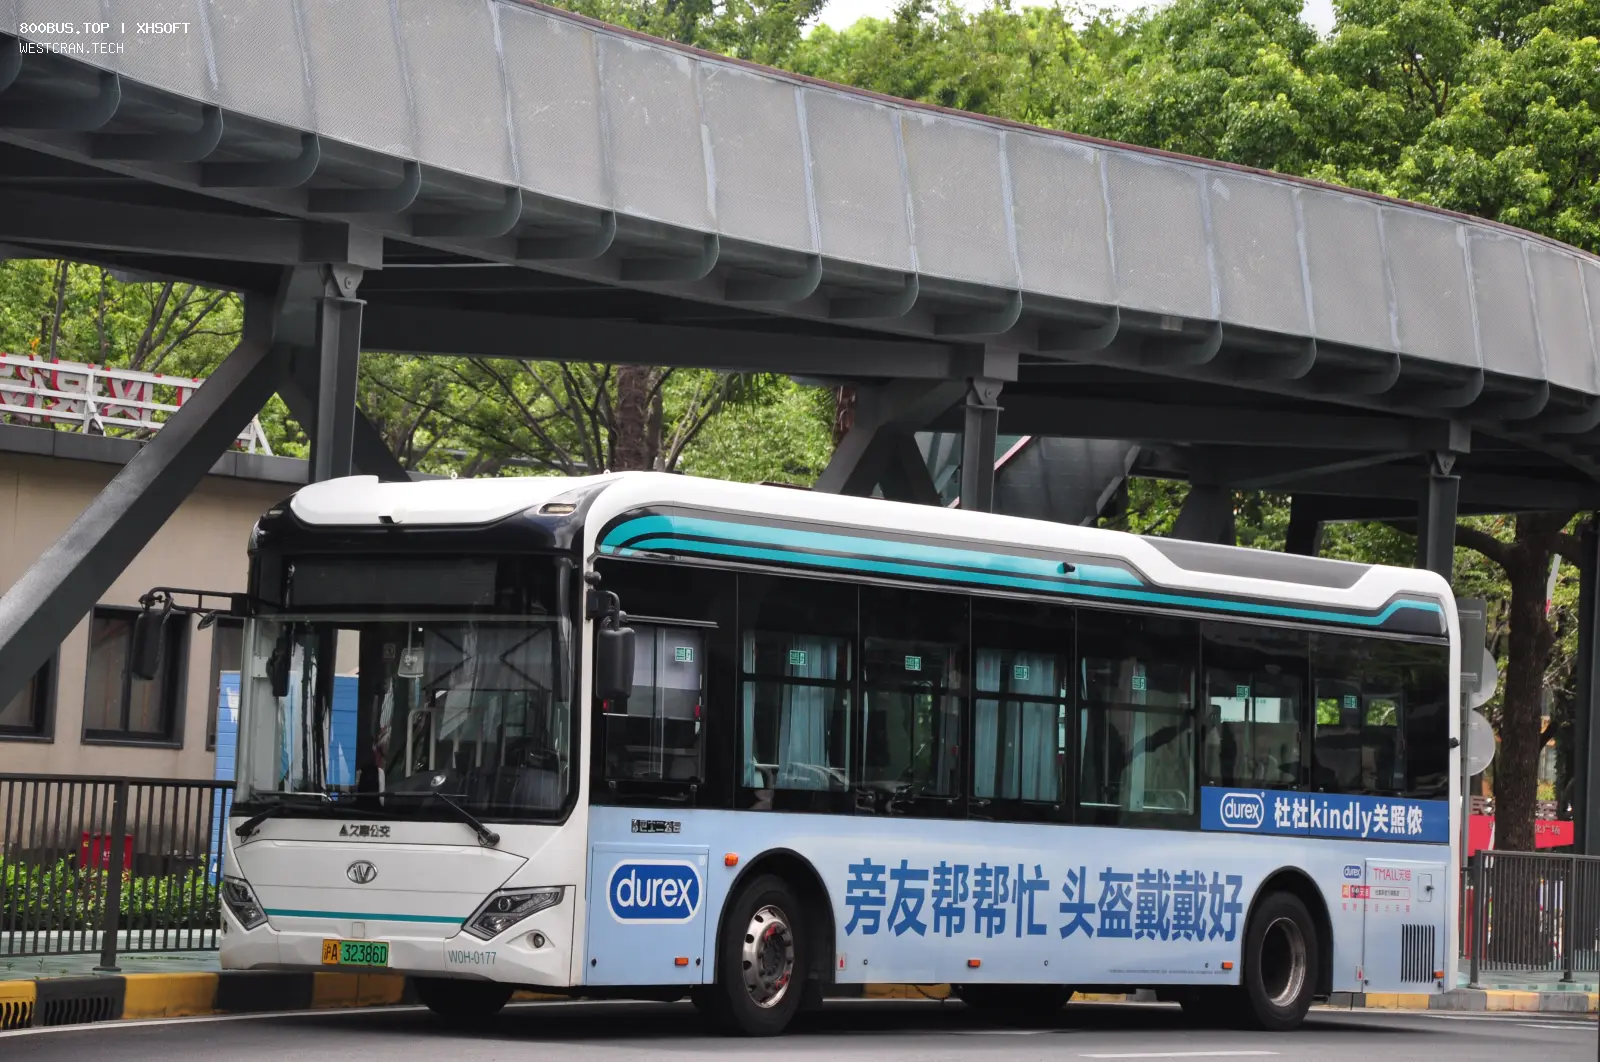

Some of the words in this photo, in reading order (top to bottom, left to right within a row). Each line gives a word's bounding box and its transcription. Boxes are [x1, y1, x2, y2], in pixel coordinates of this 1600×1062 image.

[1225, 799, 1261, 823] durex
[1274, 796, 1423, 838] 杜杜kindly关照侬
[1344, 866, 1361, 877] durex
[616, 868, 694, 915] durex
[844, 857, 1050, 939] 旁友帮帮忙
[1059, 865, 1243, 942] 头盔戴戴好
[343, 944, 388, 963] 32386D
